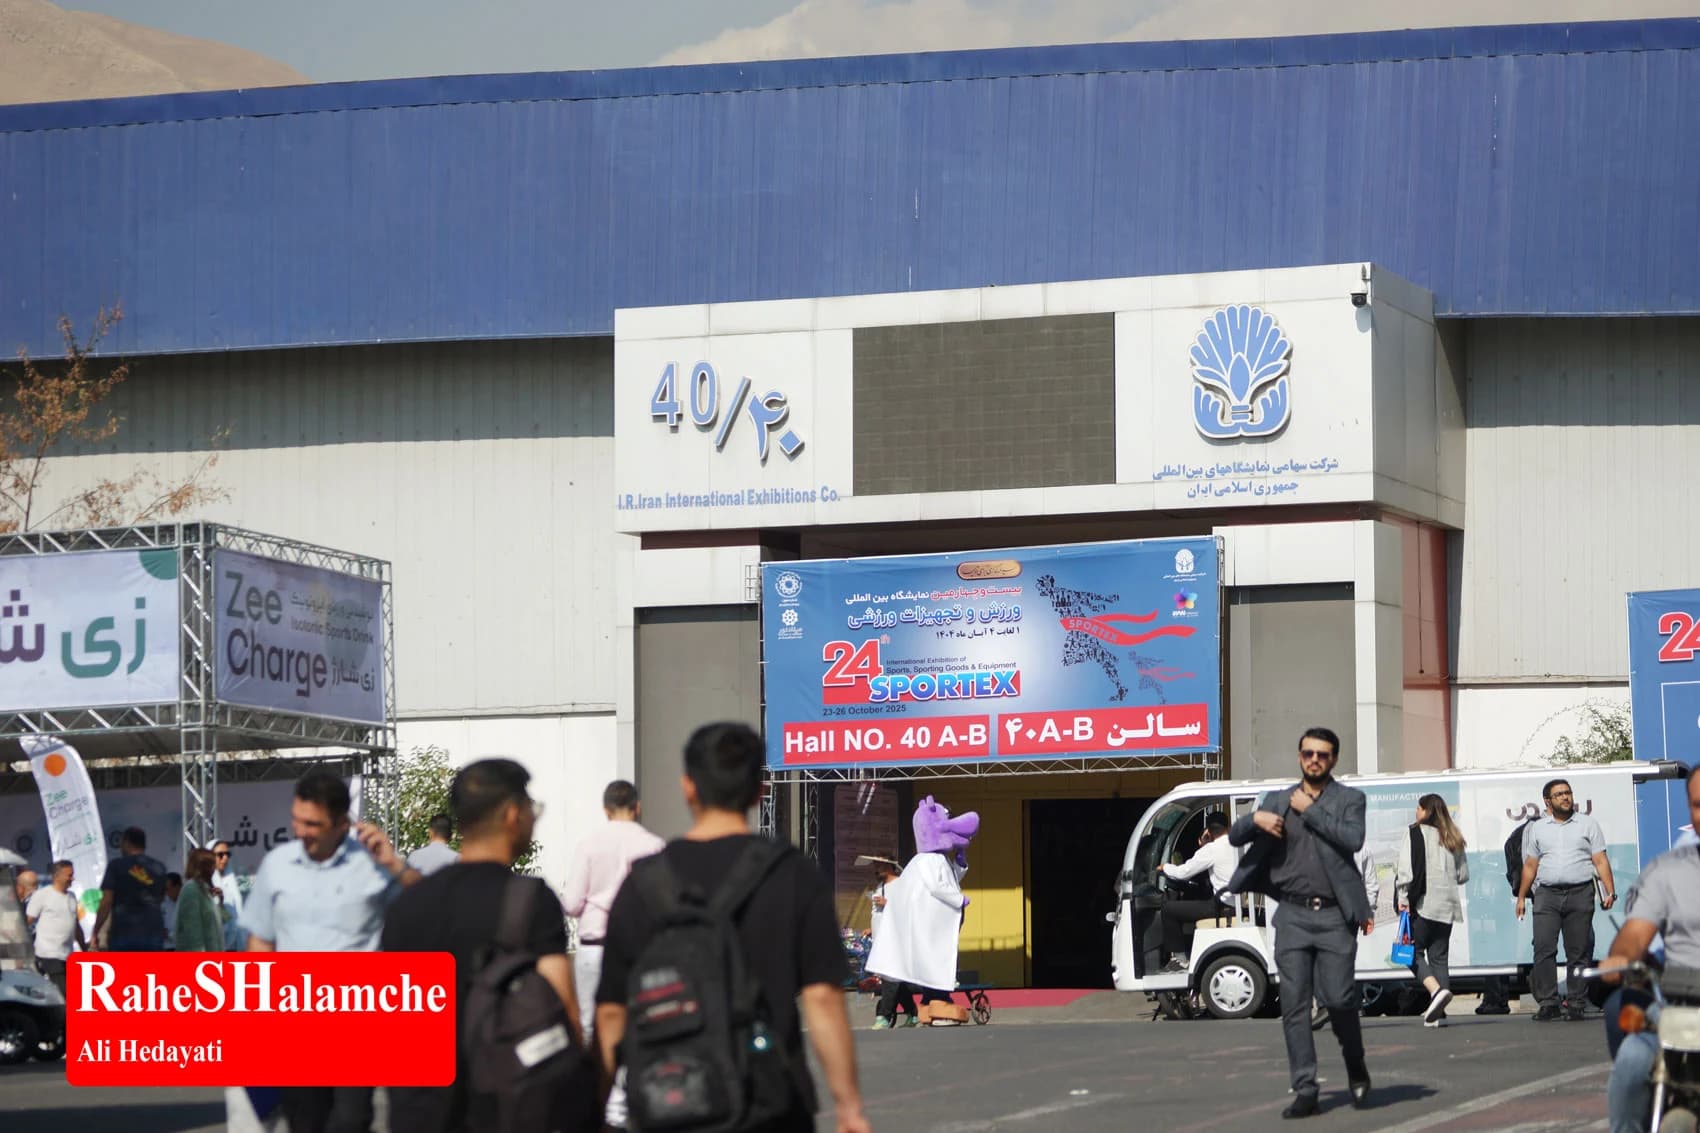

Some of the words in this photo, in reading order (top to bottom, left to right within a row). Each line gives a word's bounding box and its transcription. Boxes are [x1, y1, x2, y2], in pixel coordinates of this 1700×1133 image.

[1272, 459, 1307, 474] سهامی
[1309, 457, 1339, 473] شرکت
[665, 490, 745, 508] International
[747, 488, 817, 506] Exhibitions
[820, 485, 841, 502] Co.
[1187, 483, 1212, 498] ایران
[1214, 481, 1252, 497] اسلامی
[1254, 482, 1299, 496] جمهوری
[225, 570, 283, 625] Zee
[845, 592, 871, 605] المللی
[872, 594, 889, 604] بین
[890, 590, 930, 600] نمایشگاه
[848, 606, 898, 630] ورزشی
[900, 603, 963, 627] تجهیزات
[965, 606, 976, 624] و
[979, 601, 1022, 623] ورزش
[227, 628, 328, 698] Charge
[886, 657, 926, 665] International
[927, 656, 958, 664] Exhibition
[913, 664, 944, 674] Sporting
[945, 663, 970, 672] Goods
[978, 661, 1017, 672] Equipment
[869, 670, 1018, 702] SPORTEX
[823, 707, 846, 716] 23-26
[849, 705, 883, 715] October
[885, 704, 907, 713] 2025
[1106, 713, 1201, 747] سالن
[785, 730, 835, 753] Hall
[844, 728, 892, 751] NO.
[900, 726, 931, 748] 40
[938, 724, 988, 747] A-B
[1369, 791, 1424, 801] MANUFACTU
